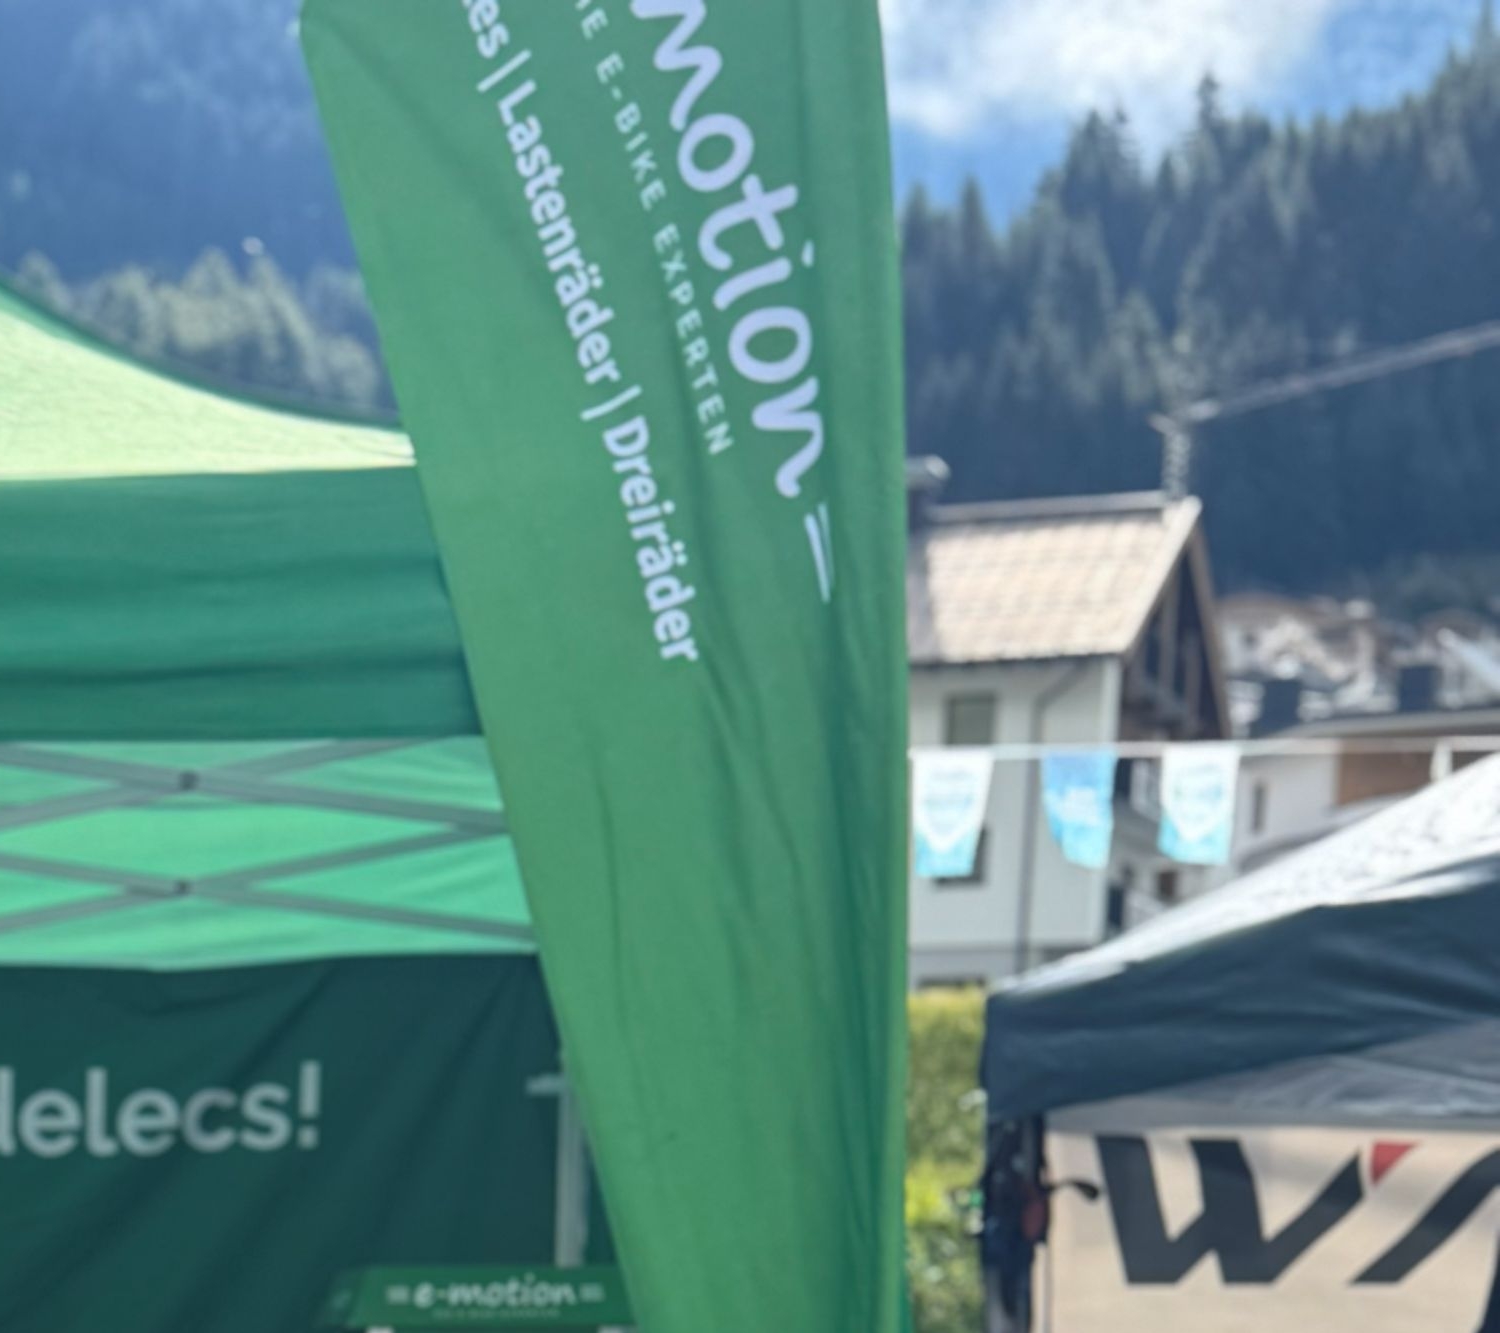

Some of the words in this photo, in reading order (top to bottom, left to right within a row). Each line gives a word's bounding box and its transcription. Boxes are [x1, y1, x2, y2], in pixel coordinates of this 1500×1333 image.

[496, 79, 622, 387] Lastenräder
[601, 413, 700, 663] Dreiräder
[595, 51, 669, 212] E-BIKE
[653, 223, 735, 456] EXPERTEN
[412, 1271, 578, 1310] e-motion
